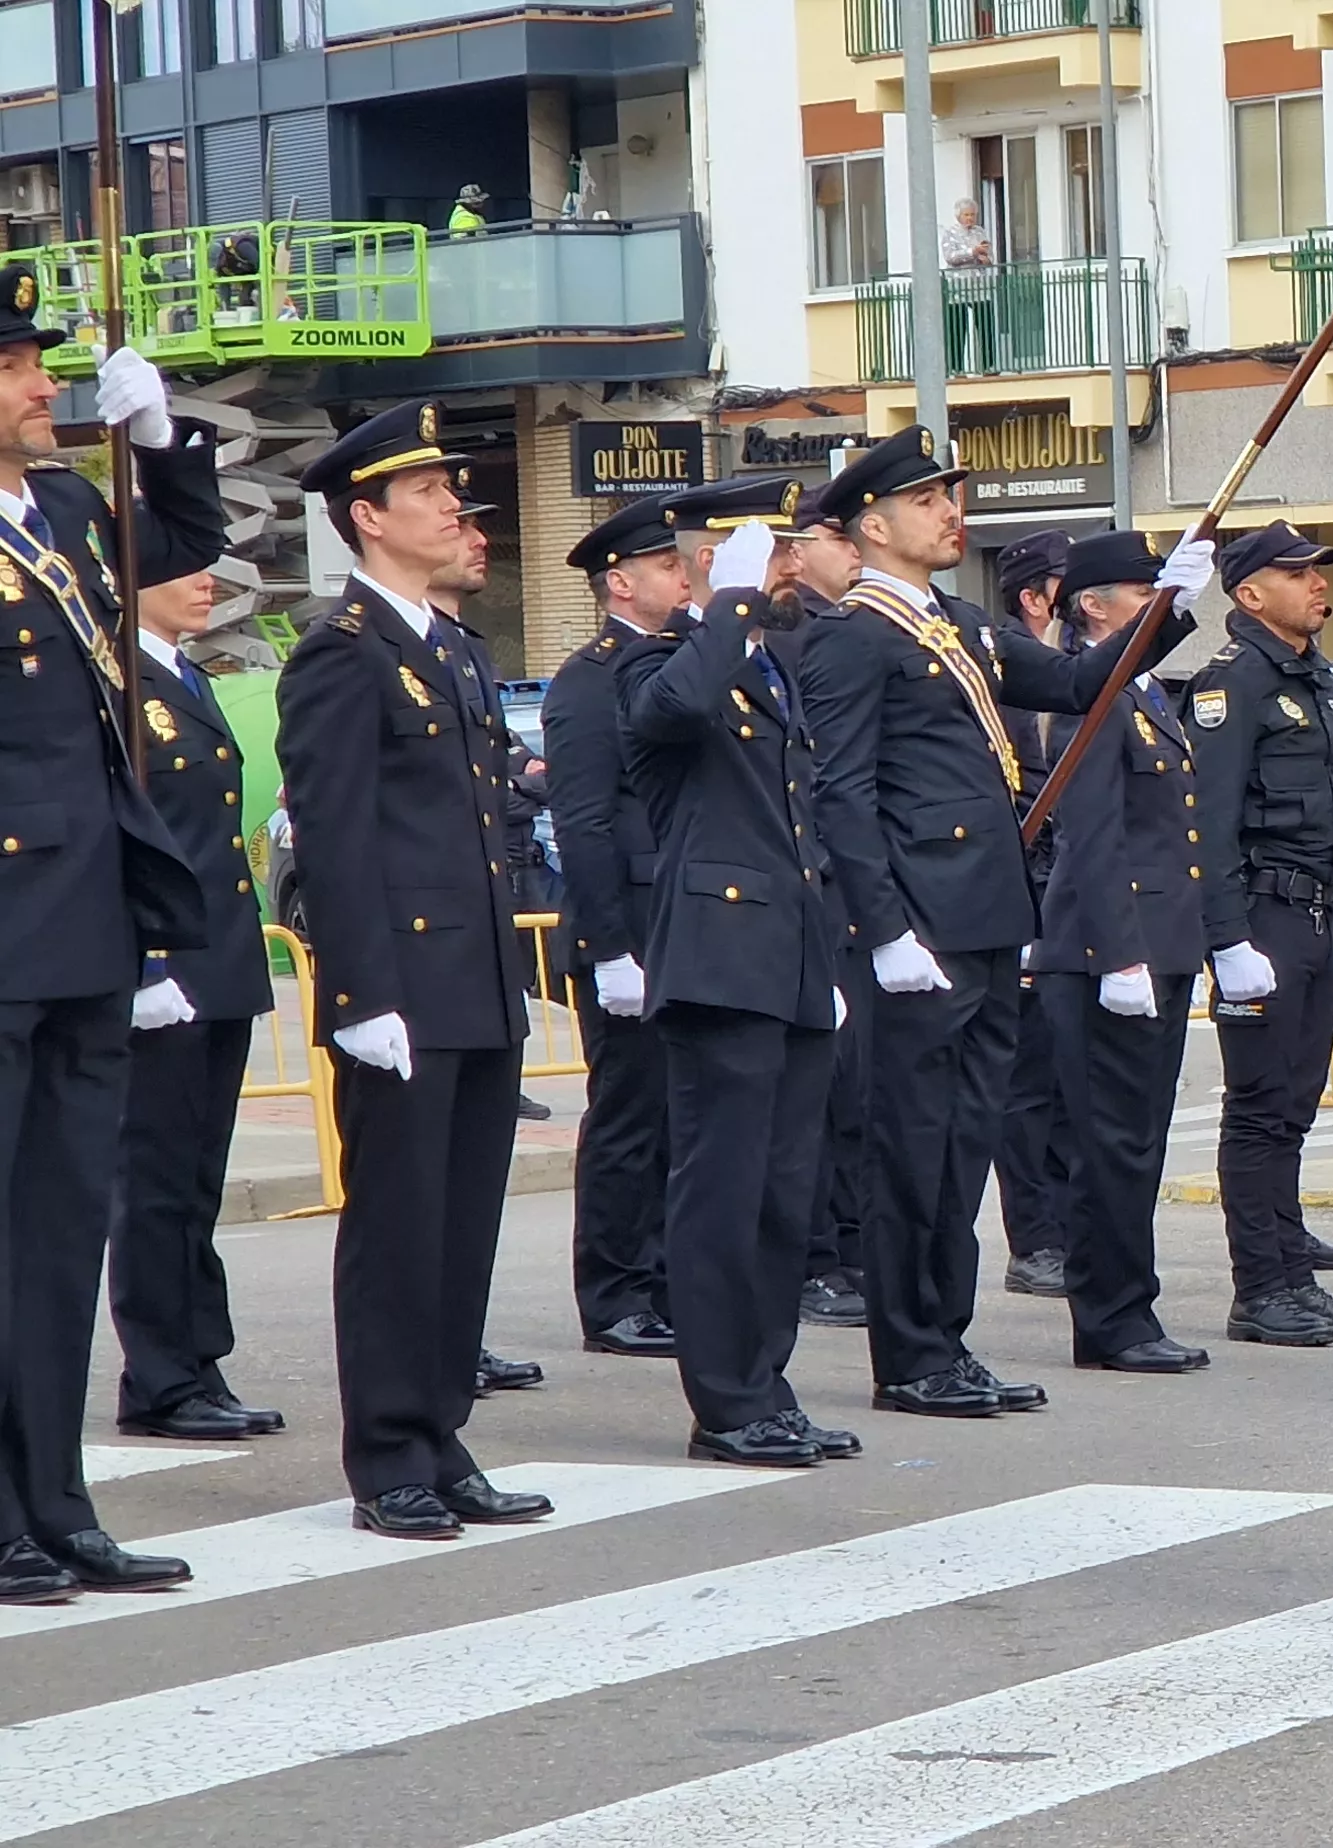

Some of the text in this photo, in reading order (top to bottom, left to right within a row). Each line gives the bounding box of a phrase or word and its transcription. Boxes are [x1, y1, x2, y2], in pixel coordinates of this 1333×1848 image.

[290, 330, 405, 346] ZOOMLION
[622, 426, 658, 449] DON
[958, 412, 1105, 475] DON QUIJOTE
[593, 449, 689, 482] QUIJOTE
[594, 483, 690, 493] BAR RESTAURANTE
[977, 478, 1086, 498] BAR RESTAURANTE
